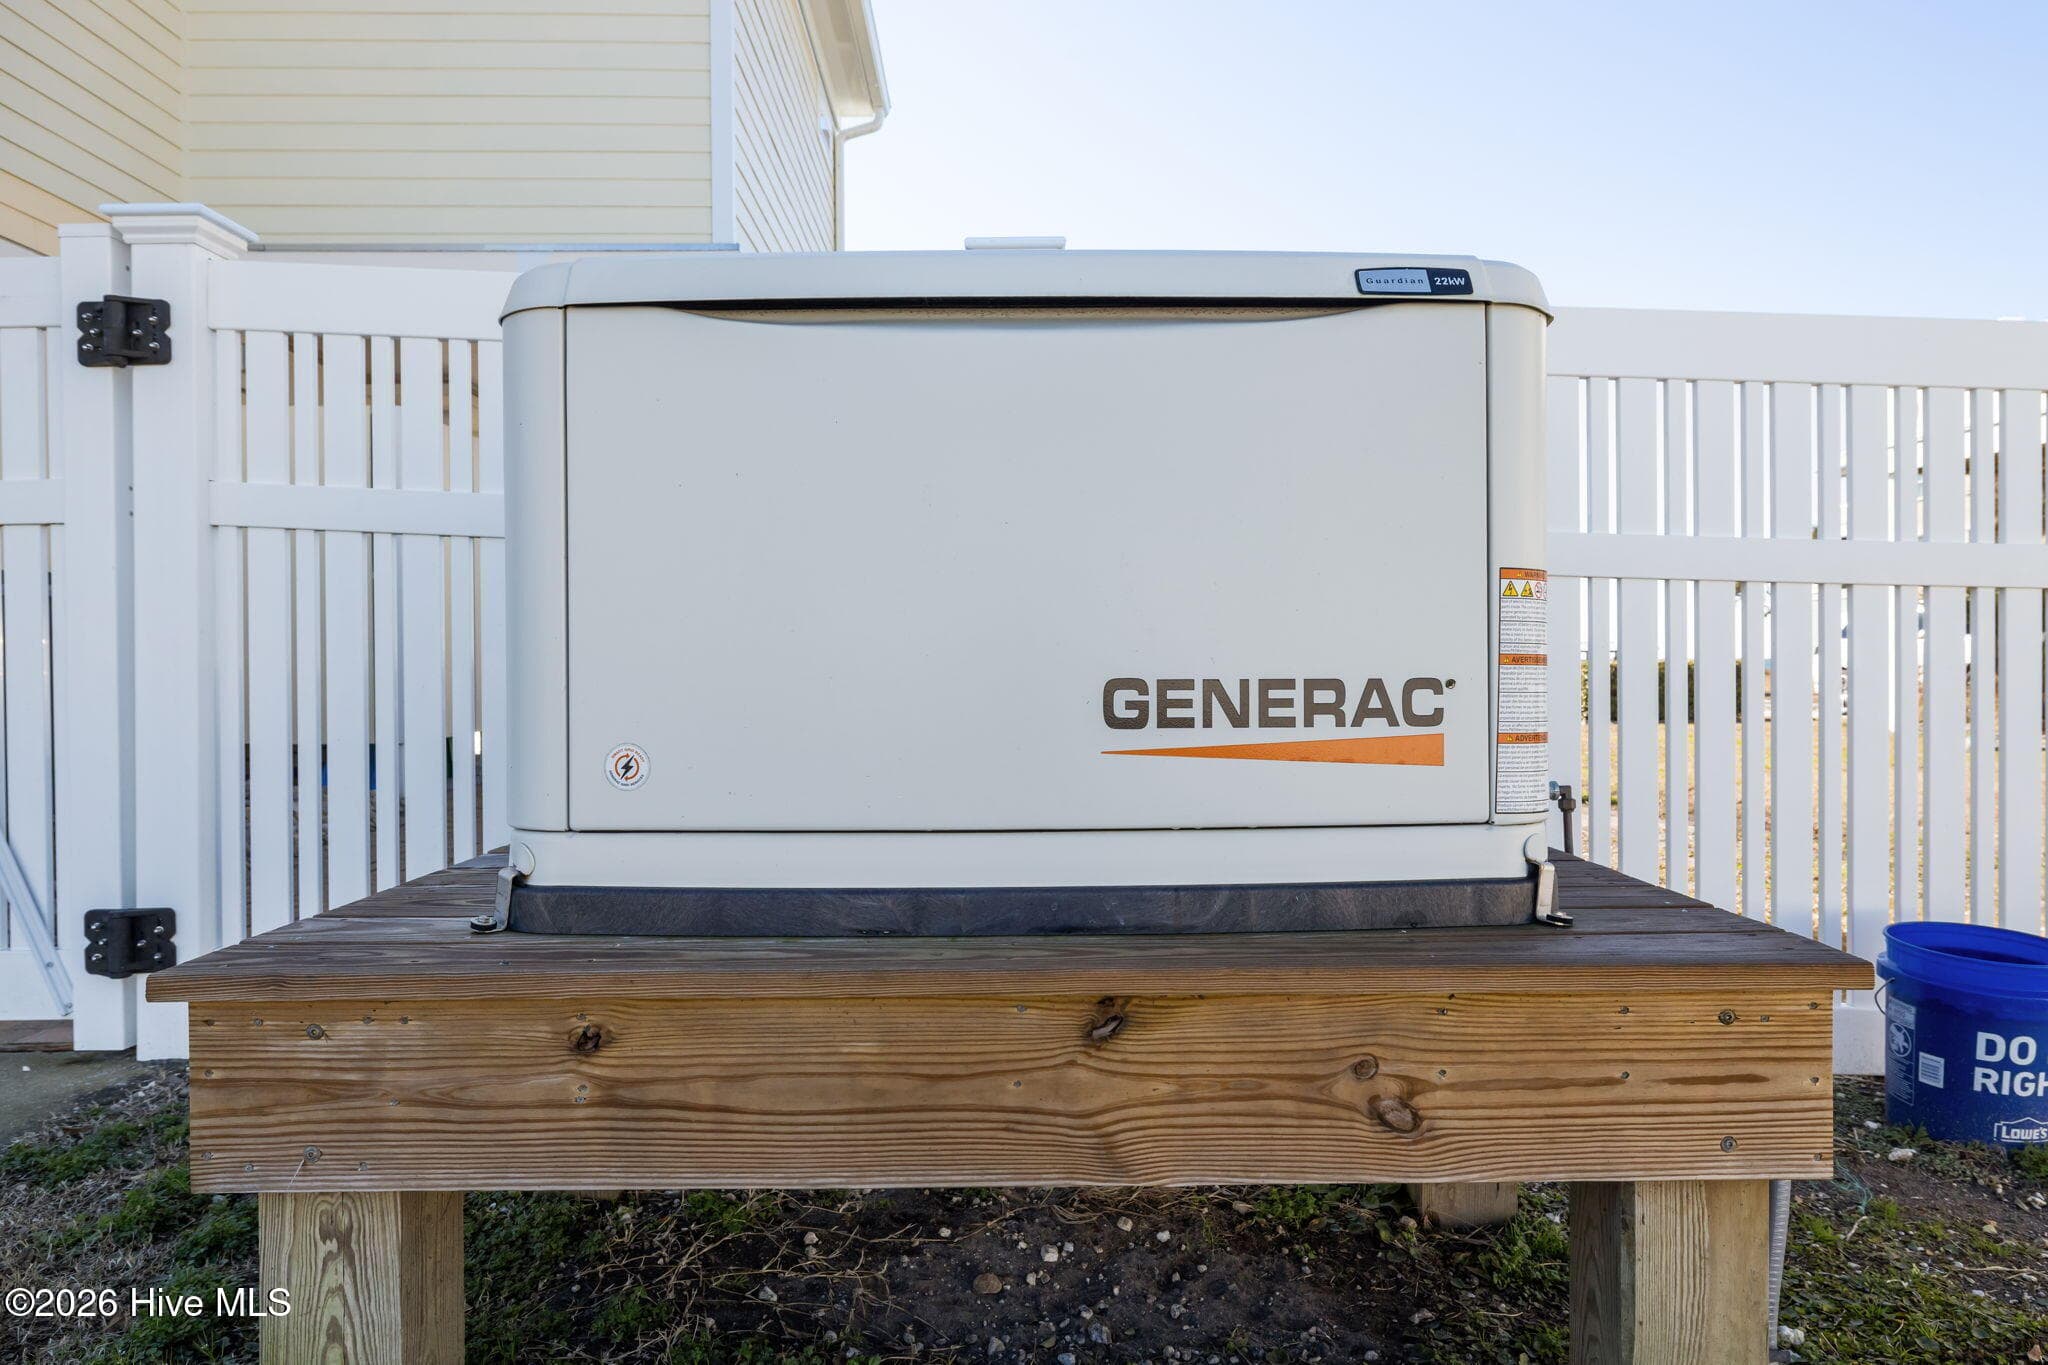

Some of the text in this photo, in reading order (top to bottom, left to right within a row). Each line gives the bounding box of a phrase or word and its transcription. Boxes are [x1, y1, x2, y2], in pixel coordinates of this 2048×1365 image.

[1365, 277, 1465, 286] Guardian 22kW
[1102, 677, 1445, 730] GENERAC
[1975, 1031, 2037, 1066] DO
[2001, 1125, 2048, 1140] LOWE'S
